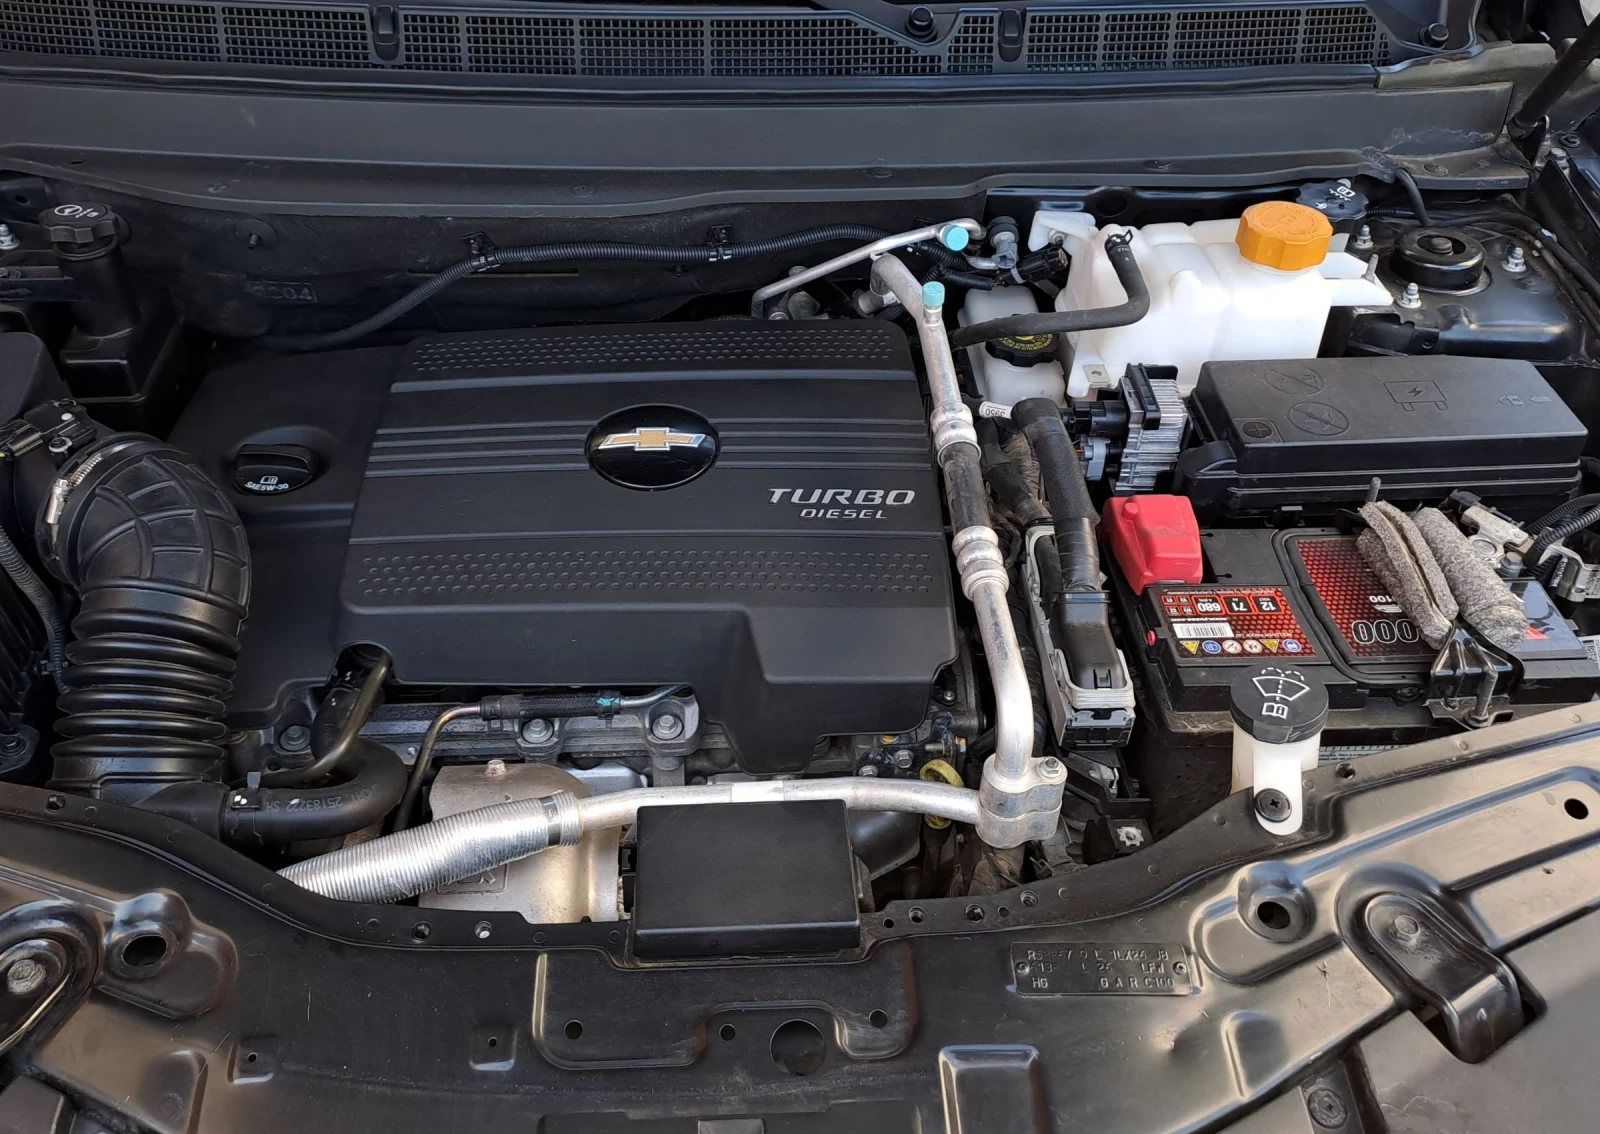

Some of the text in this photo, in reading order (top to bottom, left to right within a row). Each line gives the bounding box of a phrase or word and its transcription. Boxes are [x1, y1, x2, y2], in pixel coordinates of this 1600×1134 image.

[768, 488, 916, 505] TURBO
[799, 508, 888, 519] DIESEL
[1369, 595, 1394, 603] 100
[1197, 602, 1221, 612] 680
[1231, 602, 1247, 611] 71
[1260, 602, 1277, 611] 12
[1351, 618, 1419, 645] 000
[286, 796, 344, 812] 25183222
